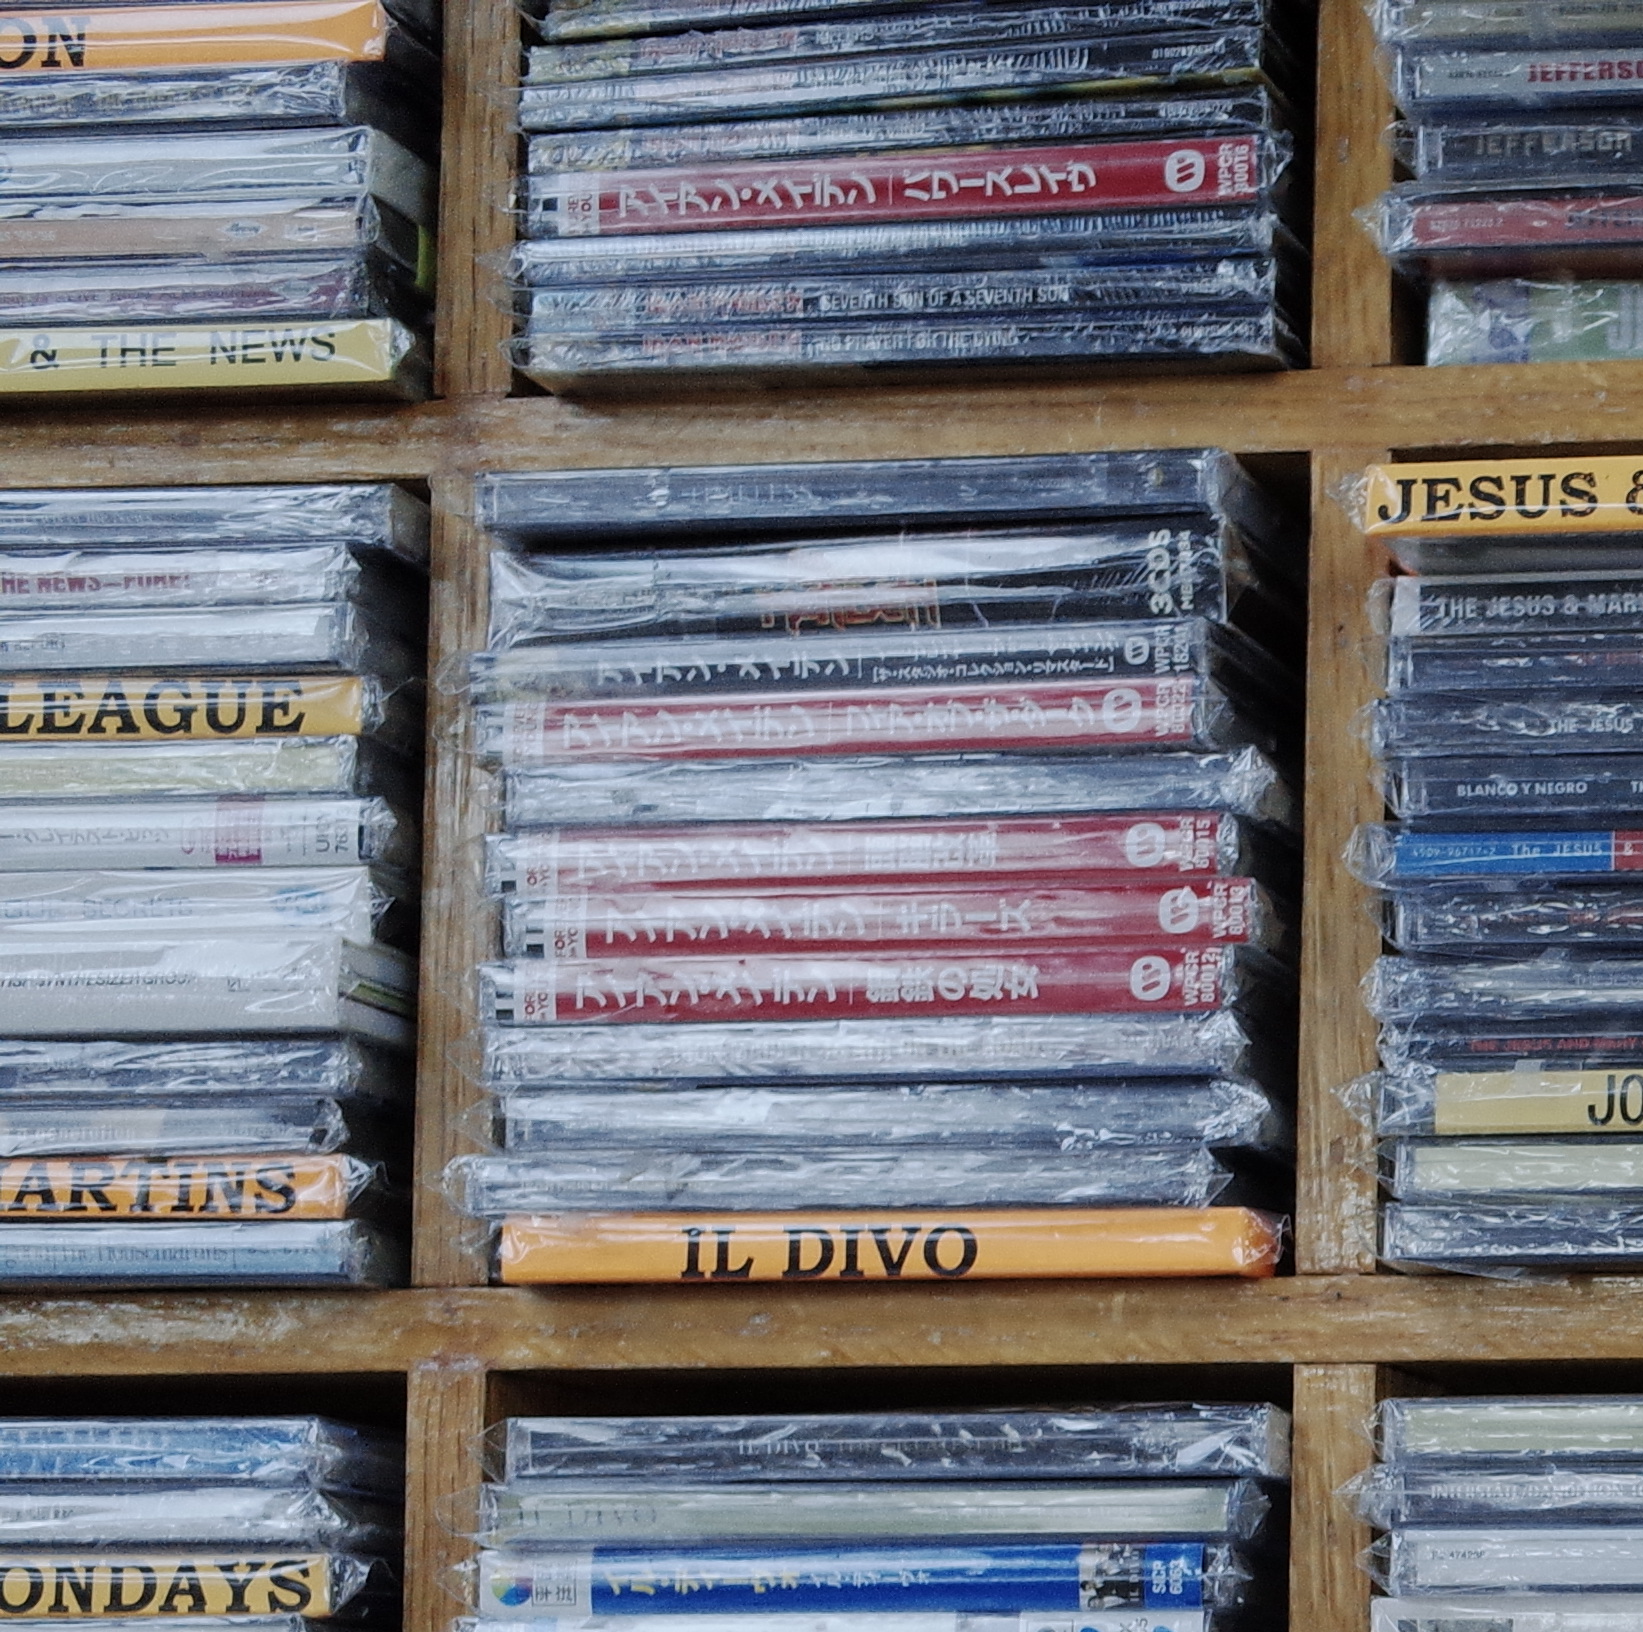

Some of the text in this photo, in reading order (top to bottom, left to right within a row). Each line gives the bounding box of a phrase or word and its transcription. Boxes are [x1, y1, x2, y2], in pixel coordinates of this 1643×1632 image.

[30, 332, 338, 369] & THE NEWS
[1378, 474, 1598, 524] JESUS
[0, 679, 306, 735] LEAGUE
[1457, 782, 1517, 797] BLANCO
[1521, 782, 1531, 796] Y
[1536, 781, 1588, 796] NEGRO
[0, 1162, 296, 1214] ARTINS
[682, 1225, 979, 1280] IL DIVO
